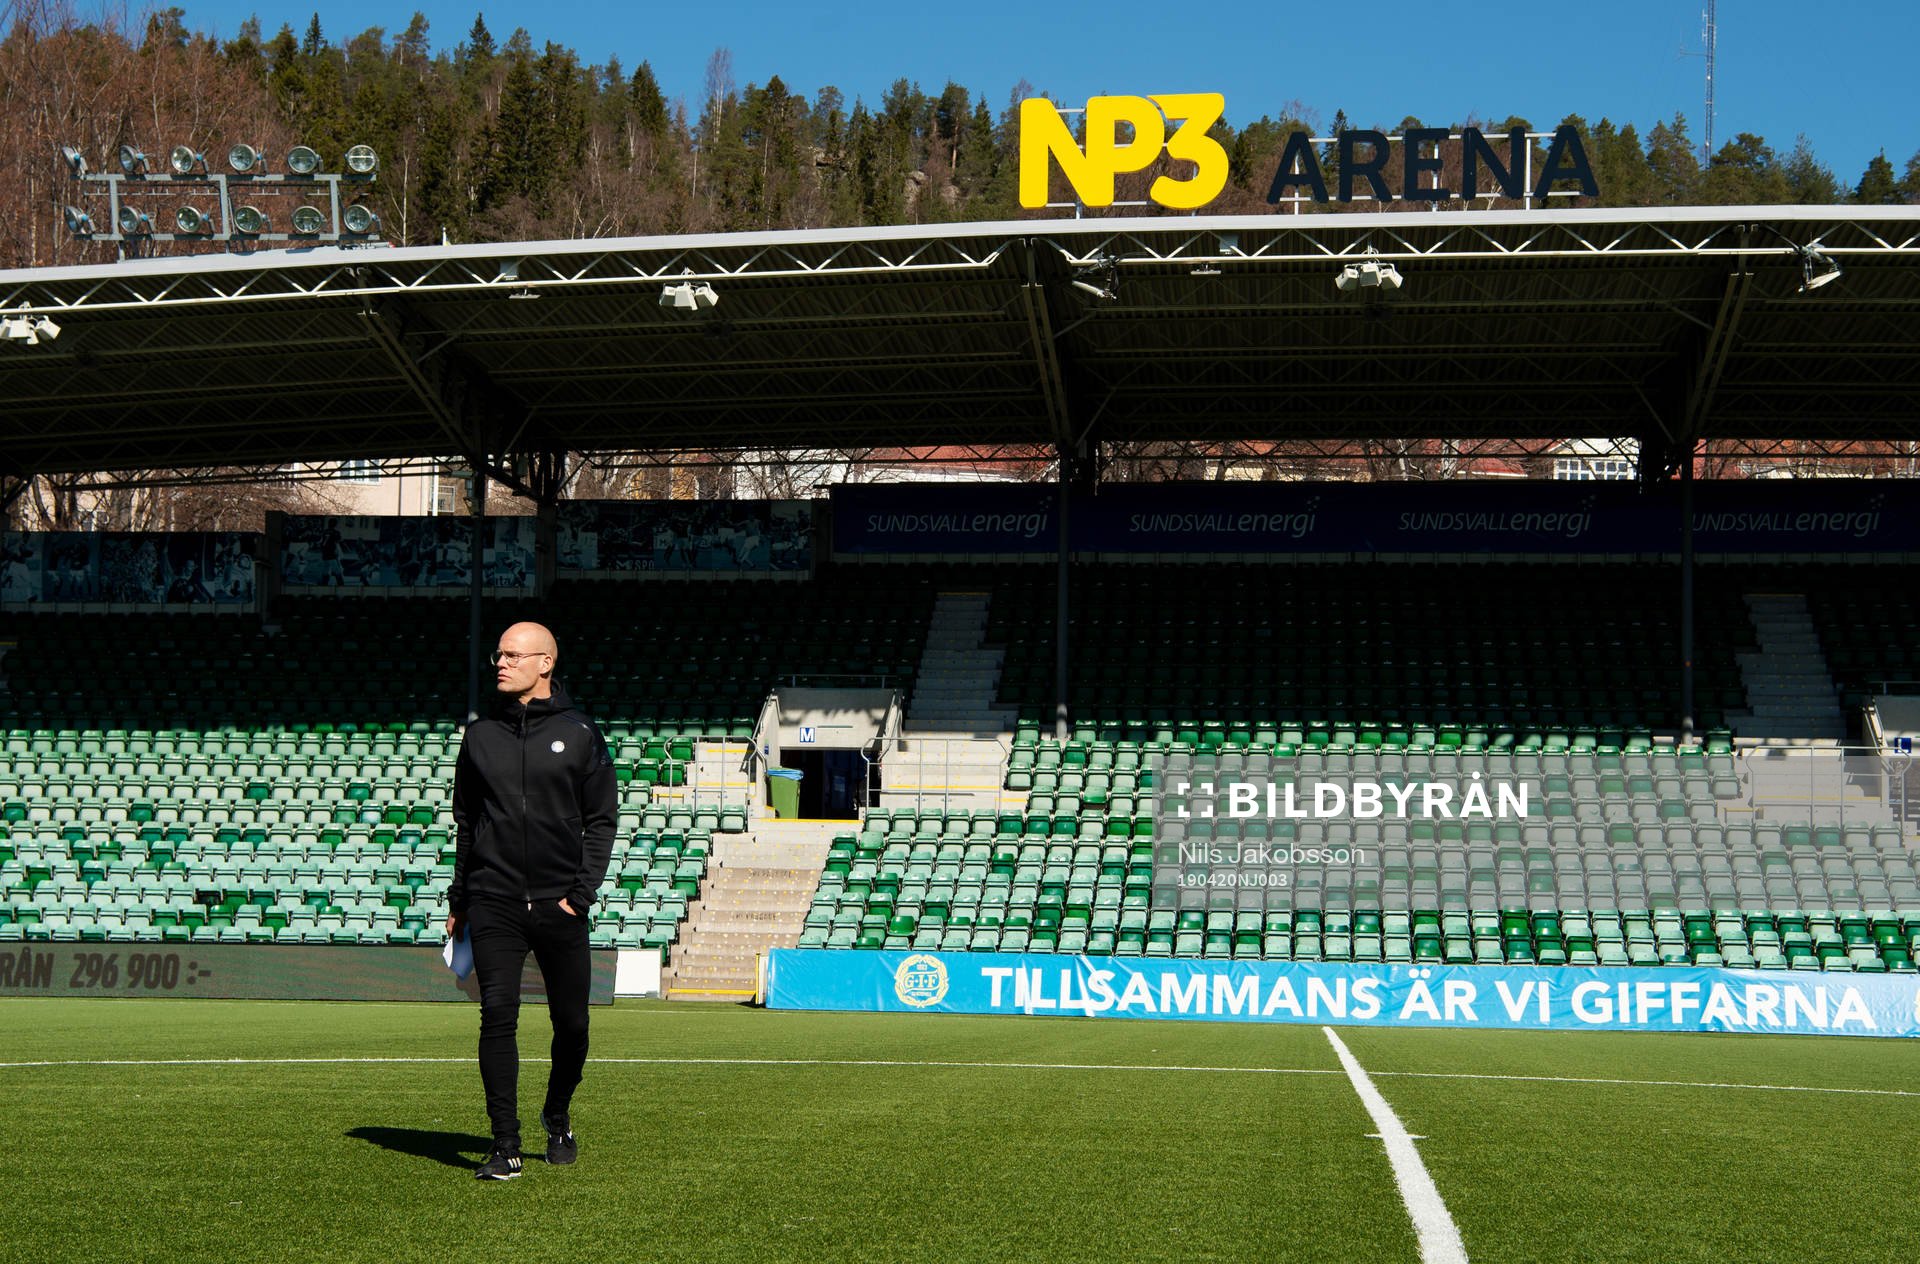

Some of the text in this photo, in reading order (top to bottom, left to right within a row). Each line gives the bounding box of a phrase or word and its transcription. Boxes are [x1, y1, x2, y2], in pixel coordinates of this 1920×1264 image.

[1020, 92, 1601, 209] NP3 ARENA
[1678, 510, 1882, 538] UNDSVALLenergi
[800, 727, 814, 742] M
[70, 953, 119, 989] 296
[128, 953, 180, 990] 900
[981, 967, 1877, 1029] TILLSAMMANS ÄR VI GIFFARNA
